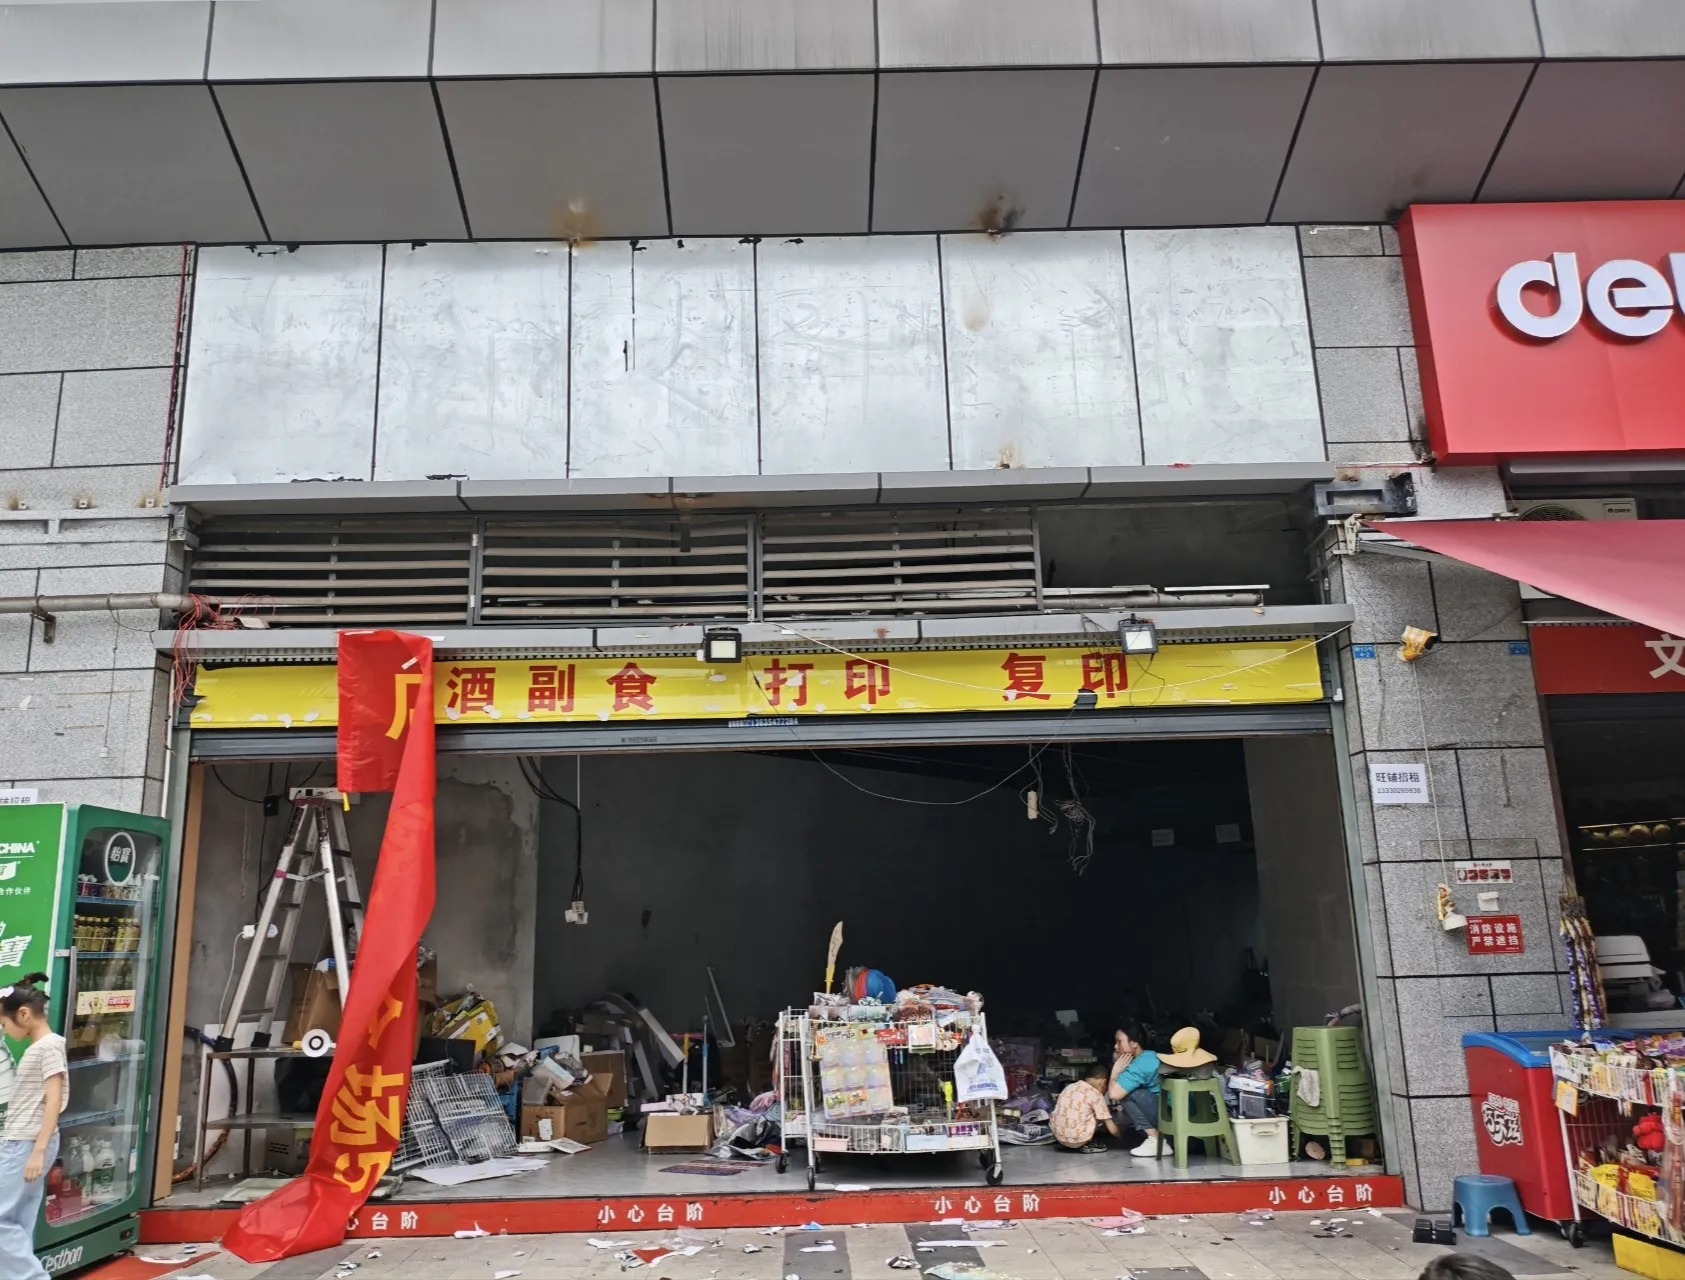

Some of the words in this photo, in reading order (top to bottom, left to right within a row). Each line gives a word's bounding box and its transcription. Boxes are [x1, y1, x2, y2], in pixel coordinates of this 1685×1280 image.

[1645, 633, 1685, 678] 文
[764, 658, 890, 706] 打印
[1001, 652, 1128, 701] 复印
[934, 1193, 1040, 1214] 小心台阶
[1268, 1183, 1373, 1205] 小心台阶
[597, 1202, 704, 1224] 小心台阶
